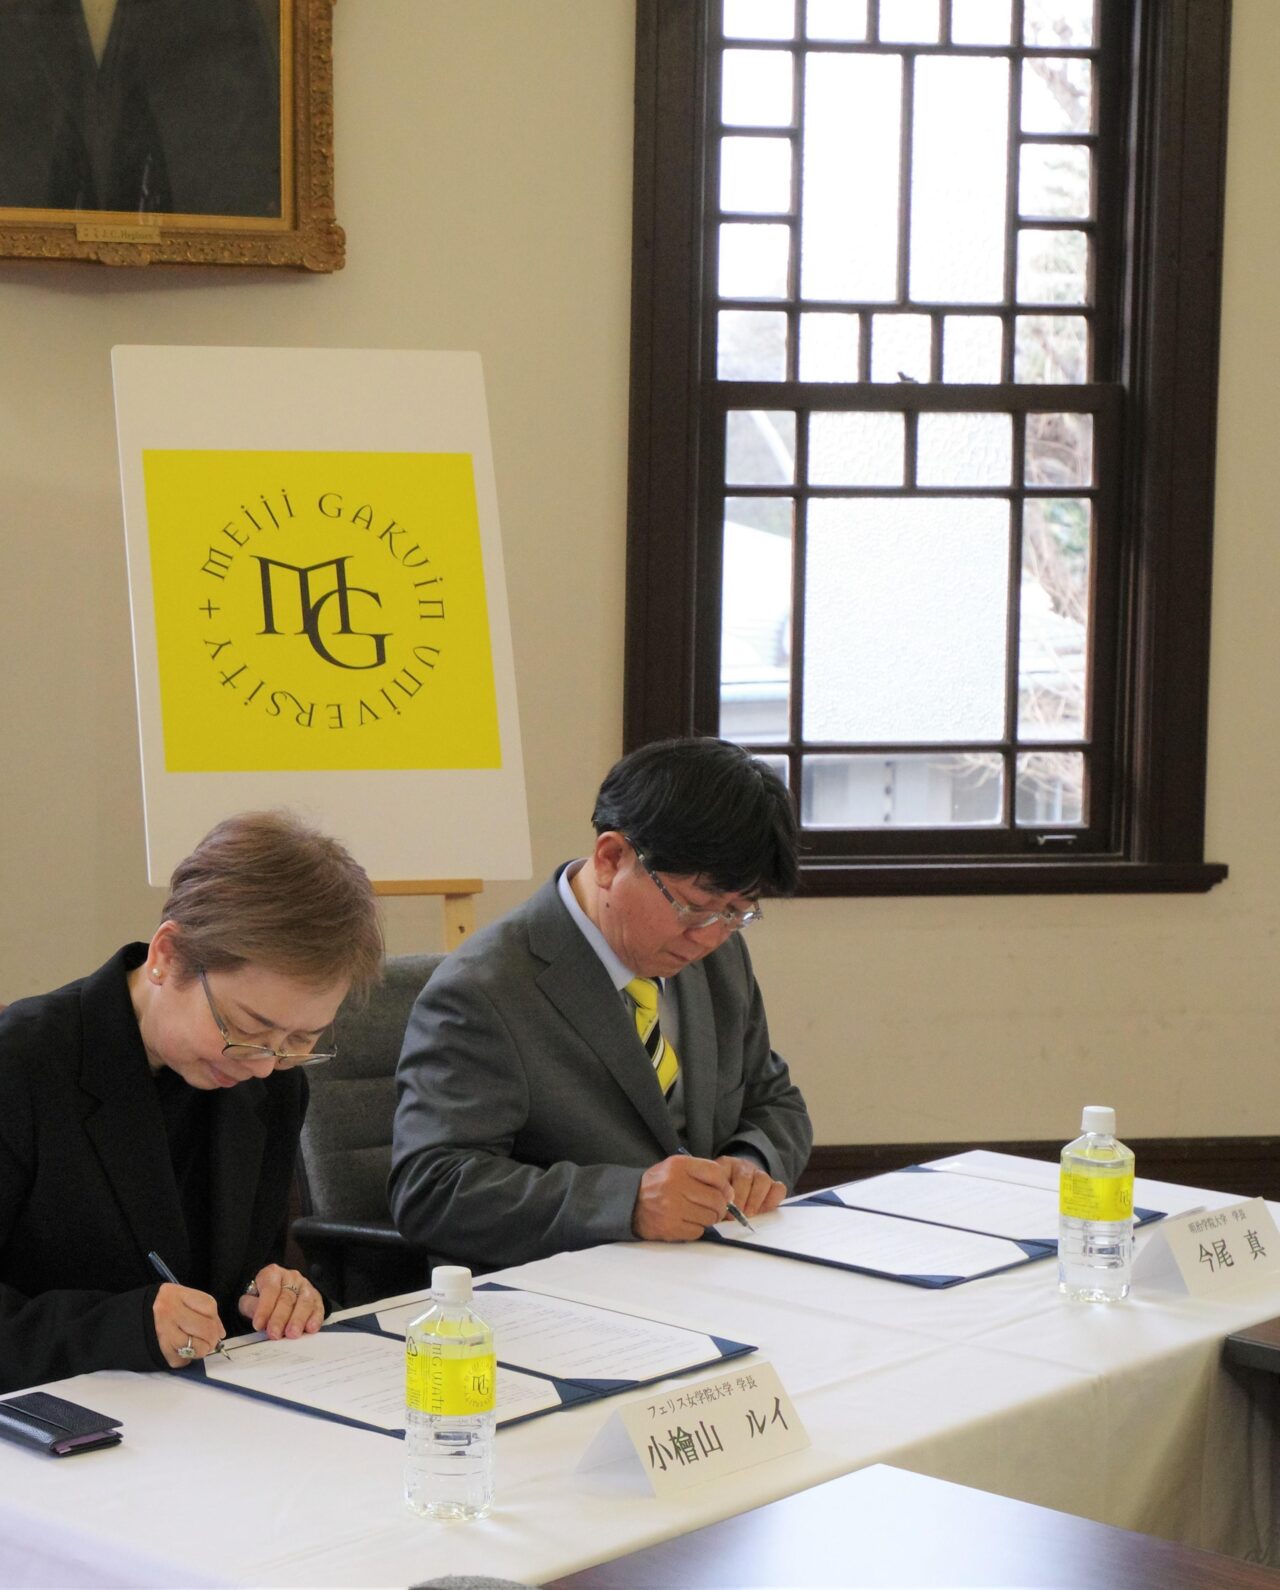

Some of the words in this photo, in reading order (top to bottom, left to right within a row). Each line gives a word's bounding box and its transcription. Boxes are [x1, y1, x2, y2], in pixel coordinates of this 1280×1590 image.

[1199, 1238, 1235, 1273] 今尾
[647, 1378, 734, 1419] フェリス女学院大学
[647, 1420, 724, 1472] 小檜山
[744, 1397, 789, 1438] ルイ
